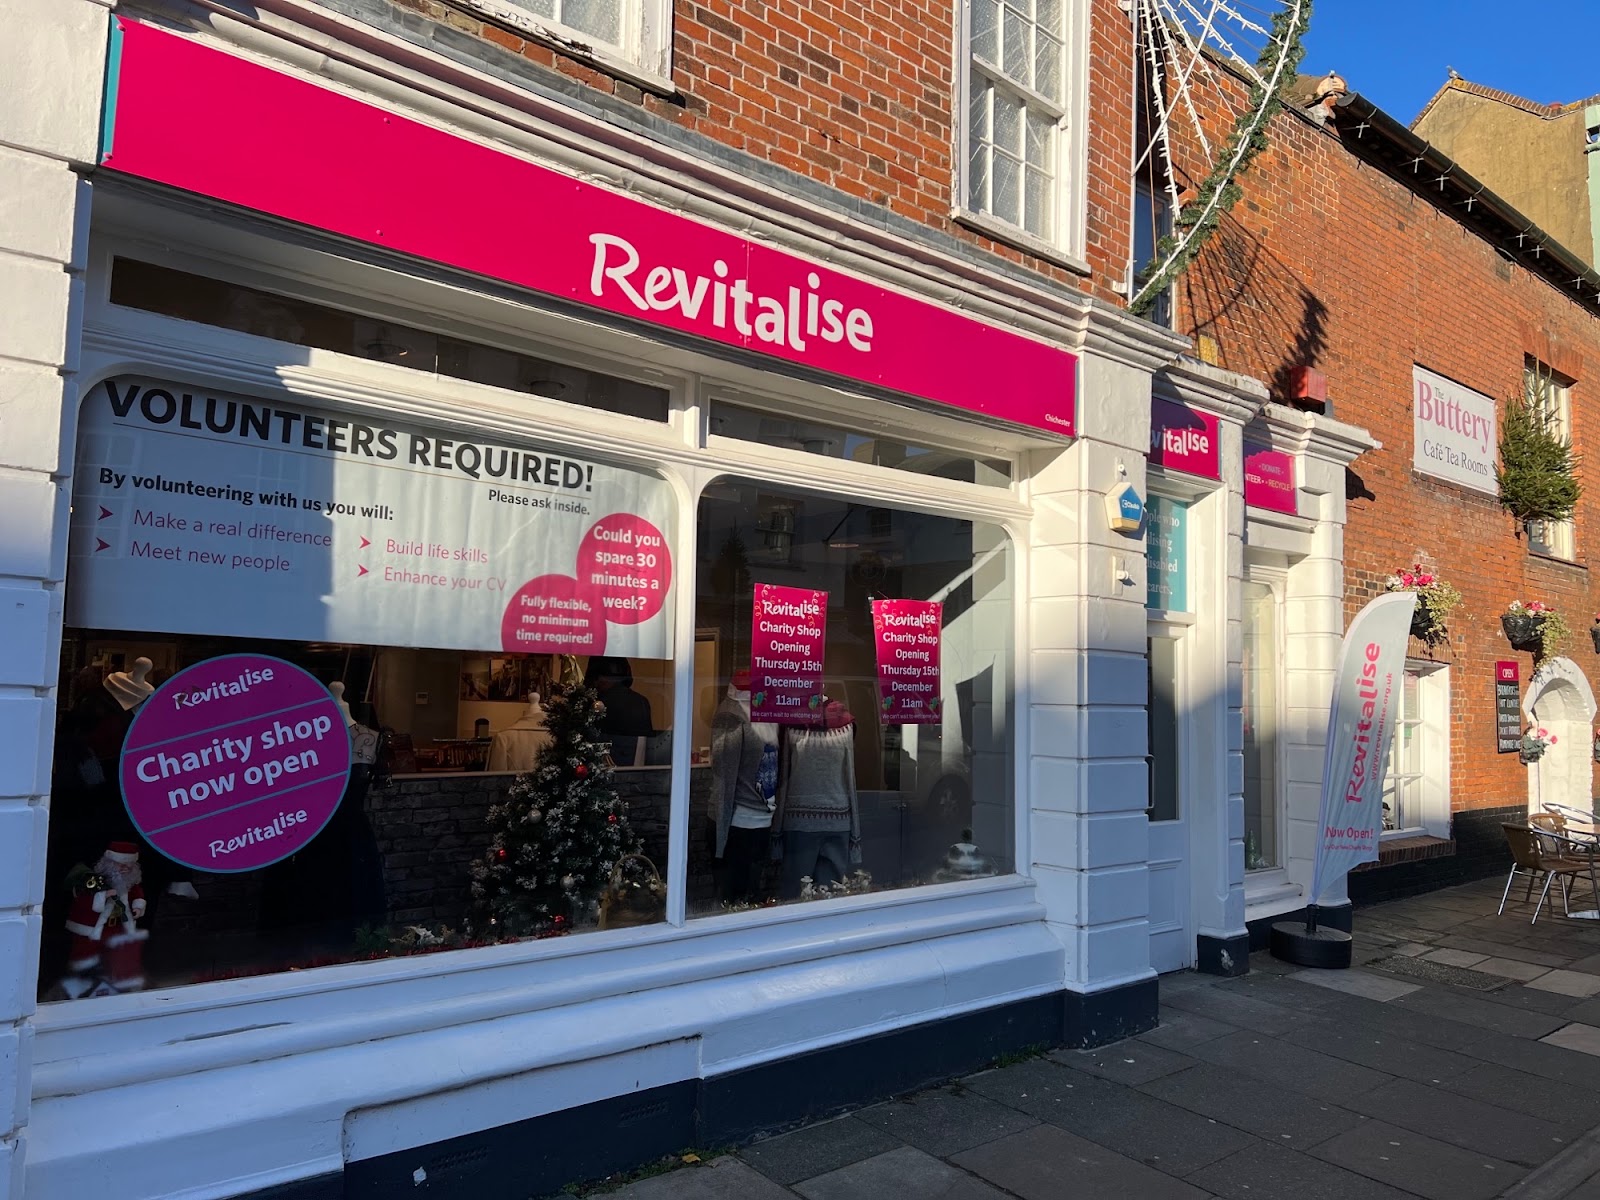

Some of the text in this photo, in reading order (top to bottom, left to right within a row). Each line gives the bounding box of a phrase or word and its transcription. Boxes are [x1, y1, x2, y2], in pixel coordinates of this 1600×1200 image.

[588, 232, 874, 353] Revitalise
[1434, 387, 1444, 399] The
[1417, 379, 1491, 454] Buttery
[104, 381, 593, 492] VOLUNTEERS REQUIRED!
[1150, 424, 1209, 456] vitalise
[1424, 439, 1488, 475] Café Tea Rooms
[100, 467, 393, 521] By volunteering with us you will:
[489, 489, 590, 515] Please ask inside.
[134, 509, 332, 546] Make a real difference
[1162, 513, 1180, 527] who
[593, 525, 660, 548] Could you
[1146, 531, 1172, 552] lising
[131, 540, 290, 572] Meet new people
[386, 539, 488, 564] Build life skills
[595, 551, 656, 567] spare 30
[384, 566, 507, 591] Enhance your CV
[591, 571, 659, 590] minutes a
[520, 595, 592, 612] Fully flexible,
[602, 596, 647, 611] week?
[762, 600, 820, 619] Revitalise
[522, 614, 589, 627] no minimum
[882, 611, 936, 629] Revitalise
[516, 629, 593, 645] time required!
[760, 621, 821, 639] Charity Shop
[882, 632, 938, 646] Charity Shop
[770, 640, 810, 656] Opening
[895, 648, 930, 662] Opening
[755, 657, 822, 672] Thursday 15th
[881, 664, 939, 678] Thursday 15th
[1502, 668, 1514, 678] OPEN
[172, 667, 274, 710] Revitalise
[764, 675, 813, 689] December
[892, 681, 933, 692] December
[775, 695, 801, 706] 11am
[901, 698, 923, 708] 11am
[1345, 642, 1380, 803] Revitalise
[1371, 672, 1393, 781] www.revitalise.org.uk
[136, 714, 332, 784] Charity shop
[168, 749, 319, 809] now open
[208, 809, 308, 858] Revitalise
[1347, 827, 1374, 841] Open!
